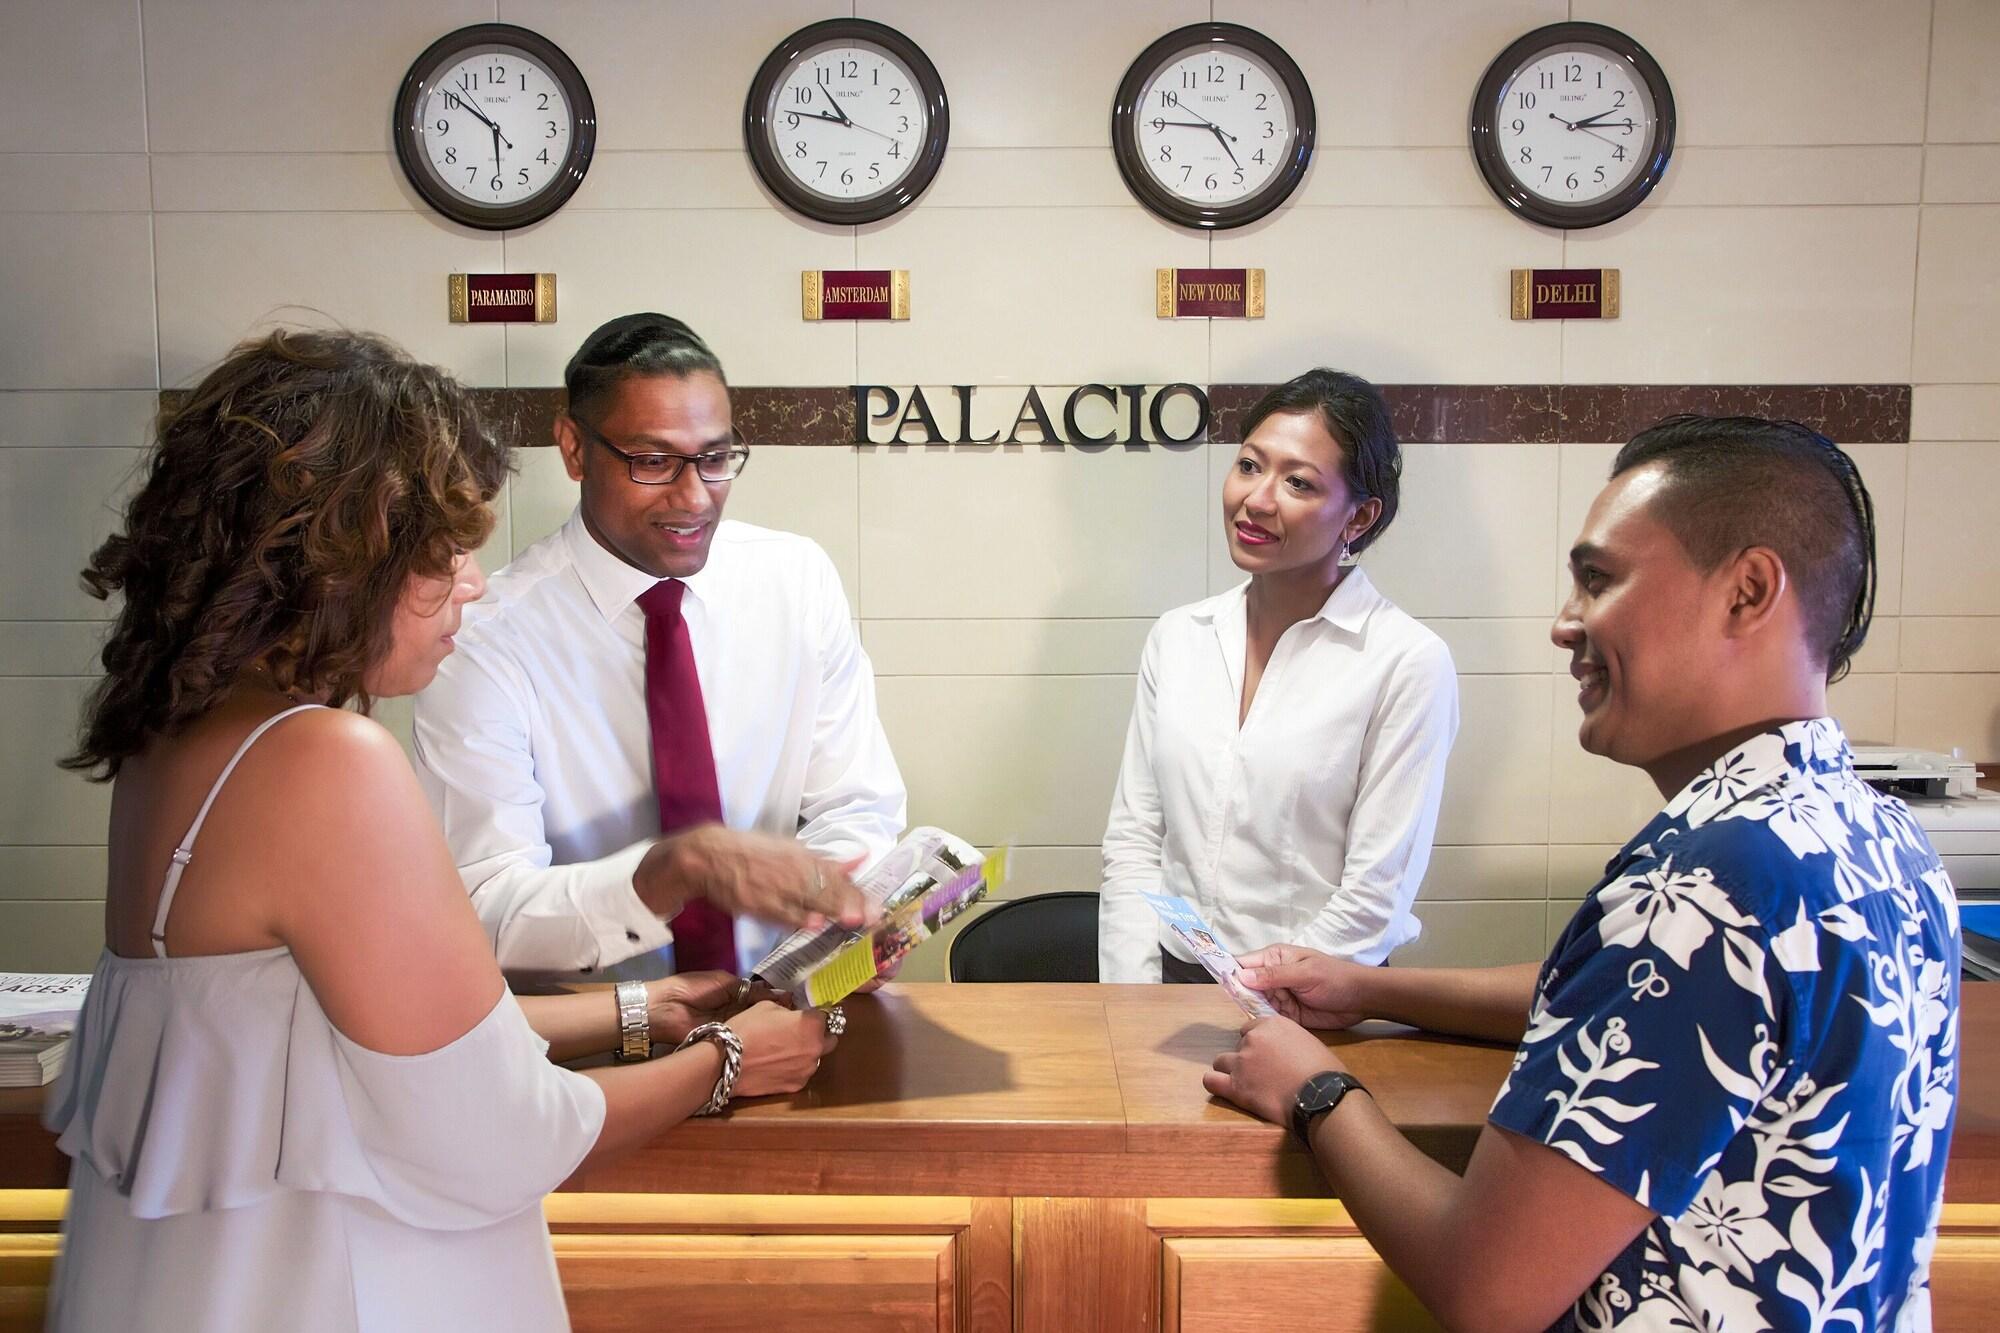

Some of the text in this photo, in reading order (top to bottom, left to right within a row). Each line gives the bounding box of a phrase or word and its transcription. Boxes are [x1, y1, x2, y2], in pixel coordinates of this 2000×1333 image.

[488, 67, 505, 83] 12
[816, 68, 829, 84] 11
[840, 61, 858, 78] 12
[873, 69, 878, 85] 1
[1207, 66, 1224, 82] 12
[1564, 65, 1582, 82] 12
[464, 73, 478, 90] 11
[521, 74, 526, 91] 1
[1183, 72, 1196, 89] 11
[1240, 74, 1244, 90] 1
[1539, 72, 1554, 89] 11
[1597, 72, 1602, 88] 1
[444, 93, 459, 110] 10
[537, 94, 548, 110] 2
[795, 87, 811, 104] 10
[889, 88, 900, 105] 2
[1161, 91, 1177, 107] 10
[1255, 94, 1267, 110] 2
[1519, 92, 1535, 109] 10
[1613, 91, 1625, 107] 2
[437, 120, 449, 136] 9
[546, 121, 556, 138] 3
[788, 113, 799, 130] 9
[897, 116, 908, 133] 3
[1153, 117, 1165, 134] 9
[1263, 121, 1274, 138] 3
[1512, 119, 1524, 136] 9
[1622, 118, 1633, 135] 3
[445, 147, 456, 164] 8
[536, 148, 549, 165] 4
[796, 141, 807, 158] 8
[887, 142, 900, 159] 4
[1160, 145, 1172, 162] 8
[1252, 148, 1264, 165] 4
[1521, 147, 1532, 164] 8
[1612, 145, 1624, 162] 4
[466, 167, 477, 184] 7
[518, 168, 529, 184] 5
[816, 161, 827, 178] 7
[841, 168, 853, 185] 6
[868, 163, 879, 179] 5
[1181, 166, 1192, 182] 7
[1232, 168, 1244, 184] 5
[1541, 166, 1552, 183] 7
[1593, 166, 1604, 183] 5
[491, 175, 503, 191] 6
[1205, 173, 1217, 190] 6
[1566, 172, 1578, 189] 6
[471, 289, 534, 306] PARAMARIBO
[824, 286, 889, 303] AMSTERDAM
[1180, 283, 1241, 301] NEW YORK
[1536, 283, 1596, 304] DELHI
[850, 383, 1211, 445] PALACIO
[0, 984, 74, 994] ACES
